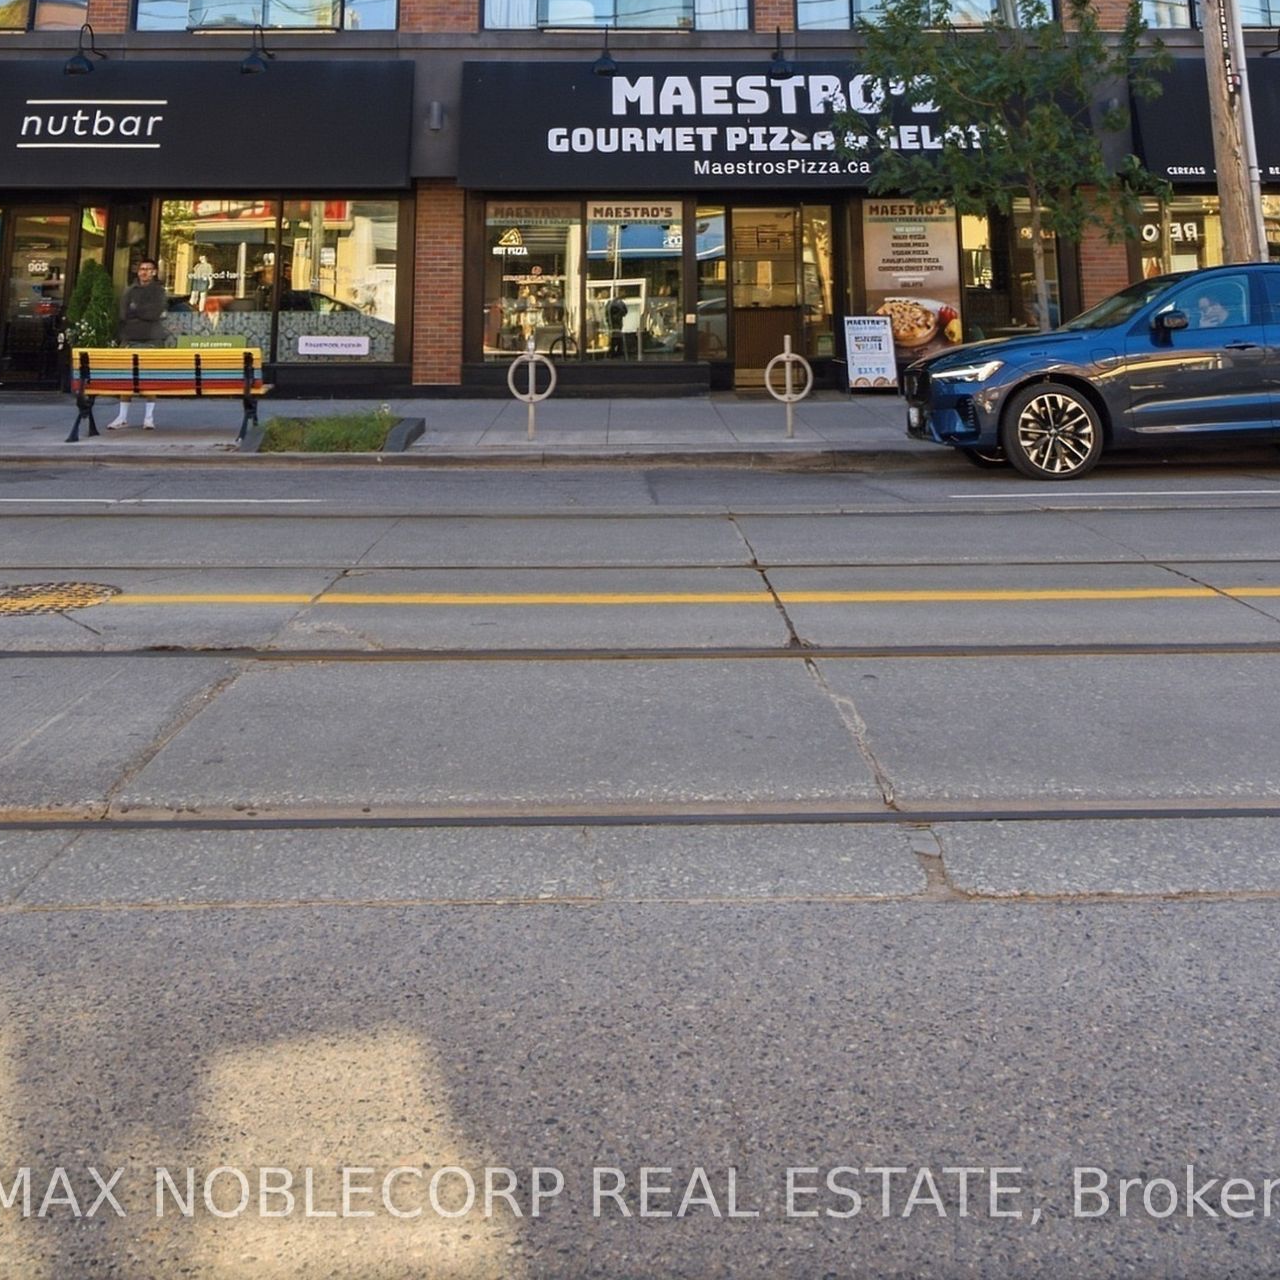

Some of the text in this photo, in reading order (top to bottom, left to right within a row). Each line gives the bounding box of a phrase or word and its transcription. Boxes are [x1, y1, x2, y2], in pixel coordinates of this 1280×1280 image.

[20, 109, 164, 136] nutbar
[547, 126, 718, 153] GOURMET
[725, 126, 836, 151] PIZZA
[693, 159, 871, 175] MaestrosPizza.ca
[1167, 166, 1206, 175] CEREALS
